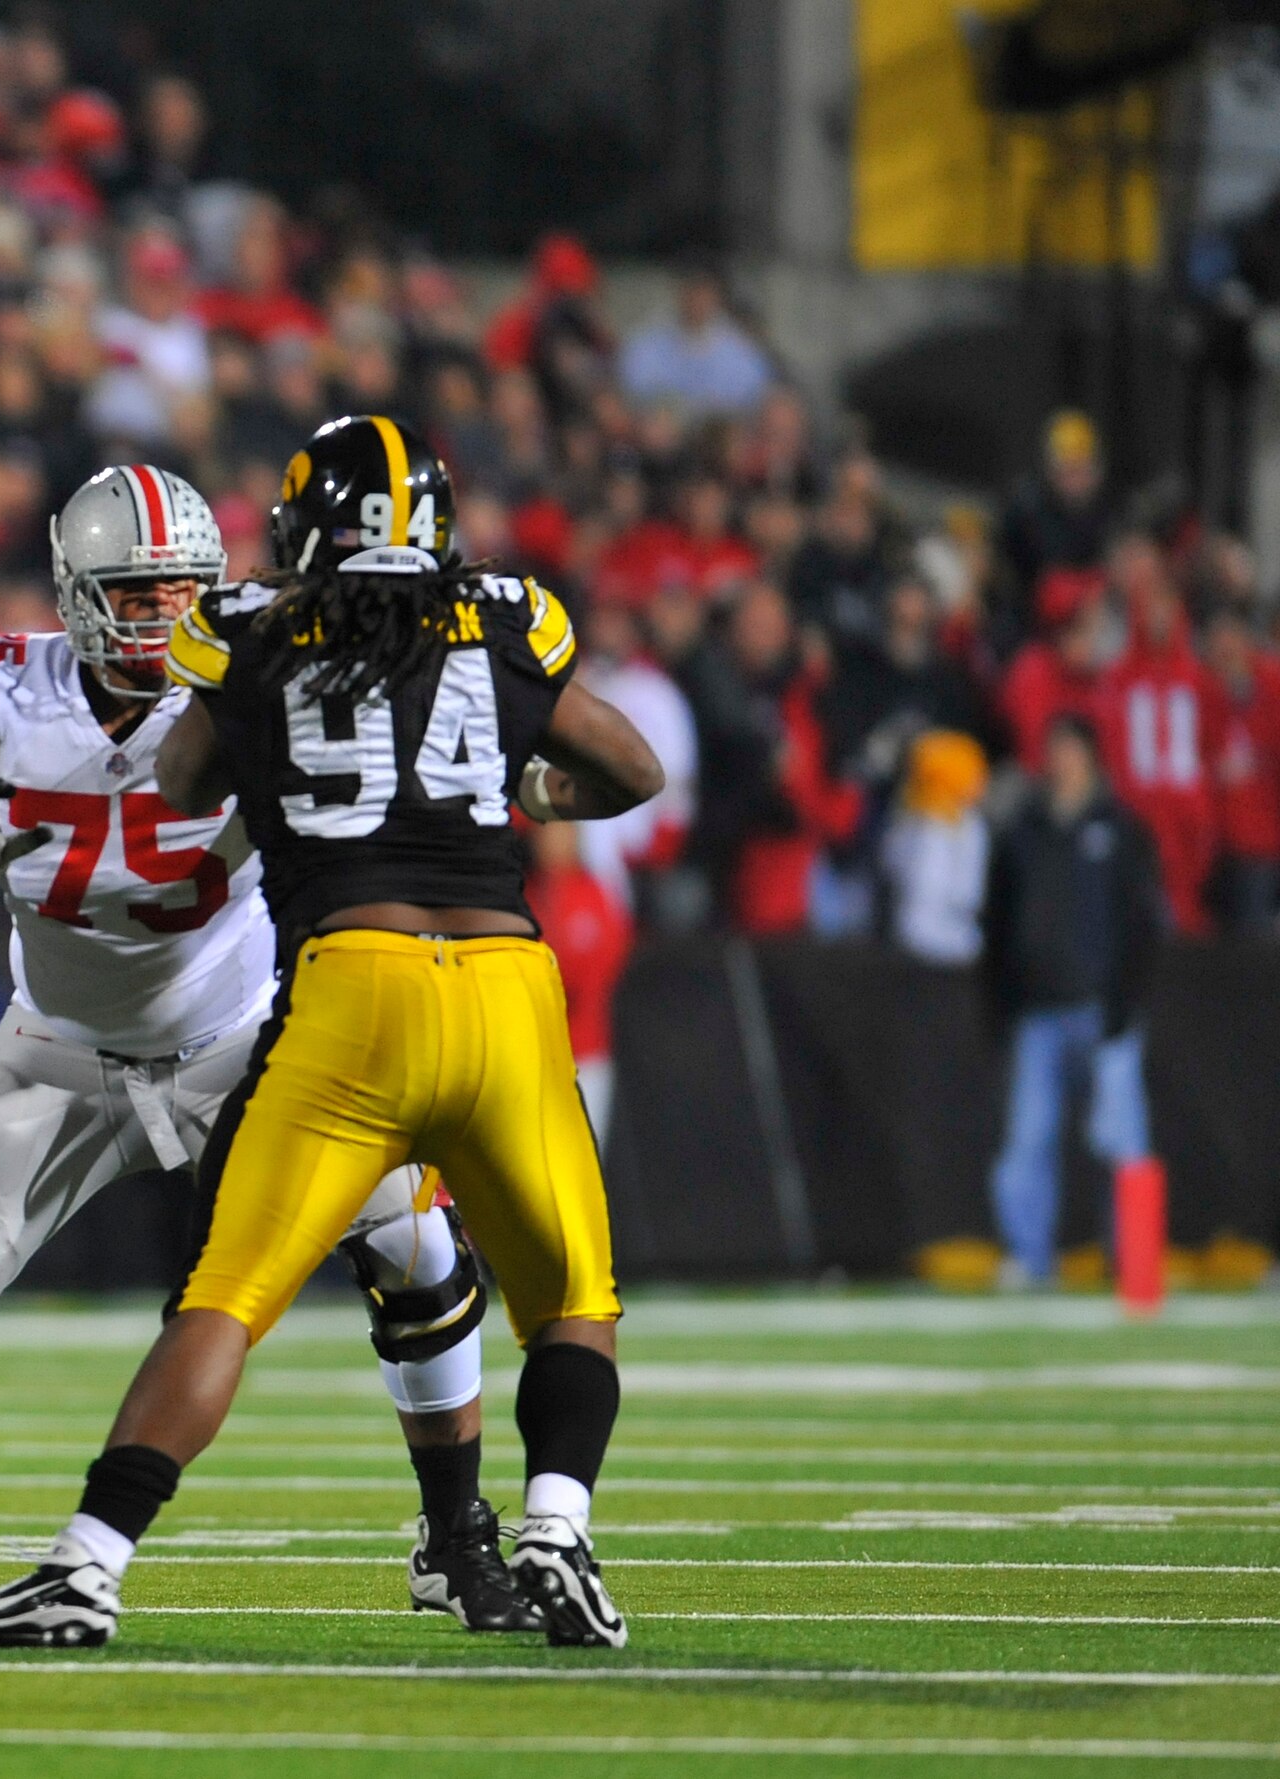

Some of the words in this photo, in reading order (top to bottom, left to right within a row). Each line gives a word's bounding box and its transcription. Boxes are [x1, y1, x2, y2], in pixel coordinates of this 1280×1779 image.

[360, 493, 436, 550] 94
[280, 648, 510, 838] 94
[9, 788, 230, 933] 75
